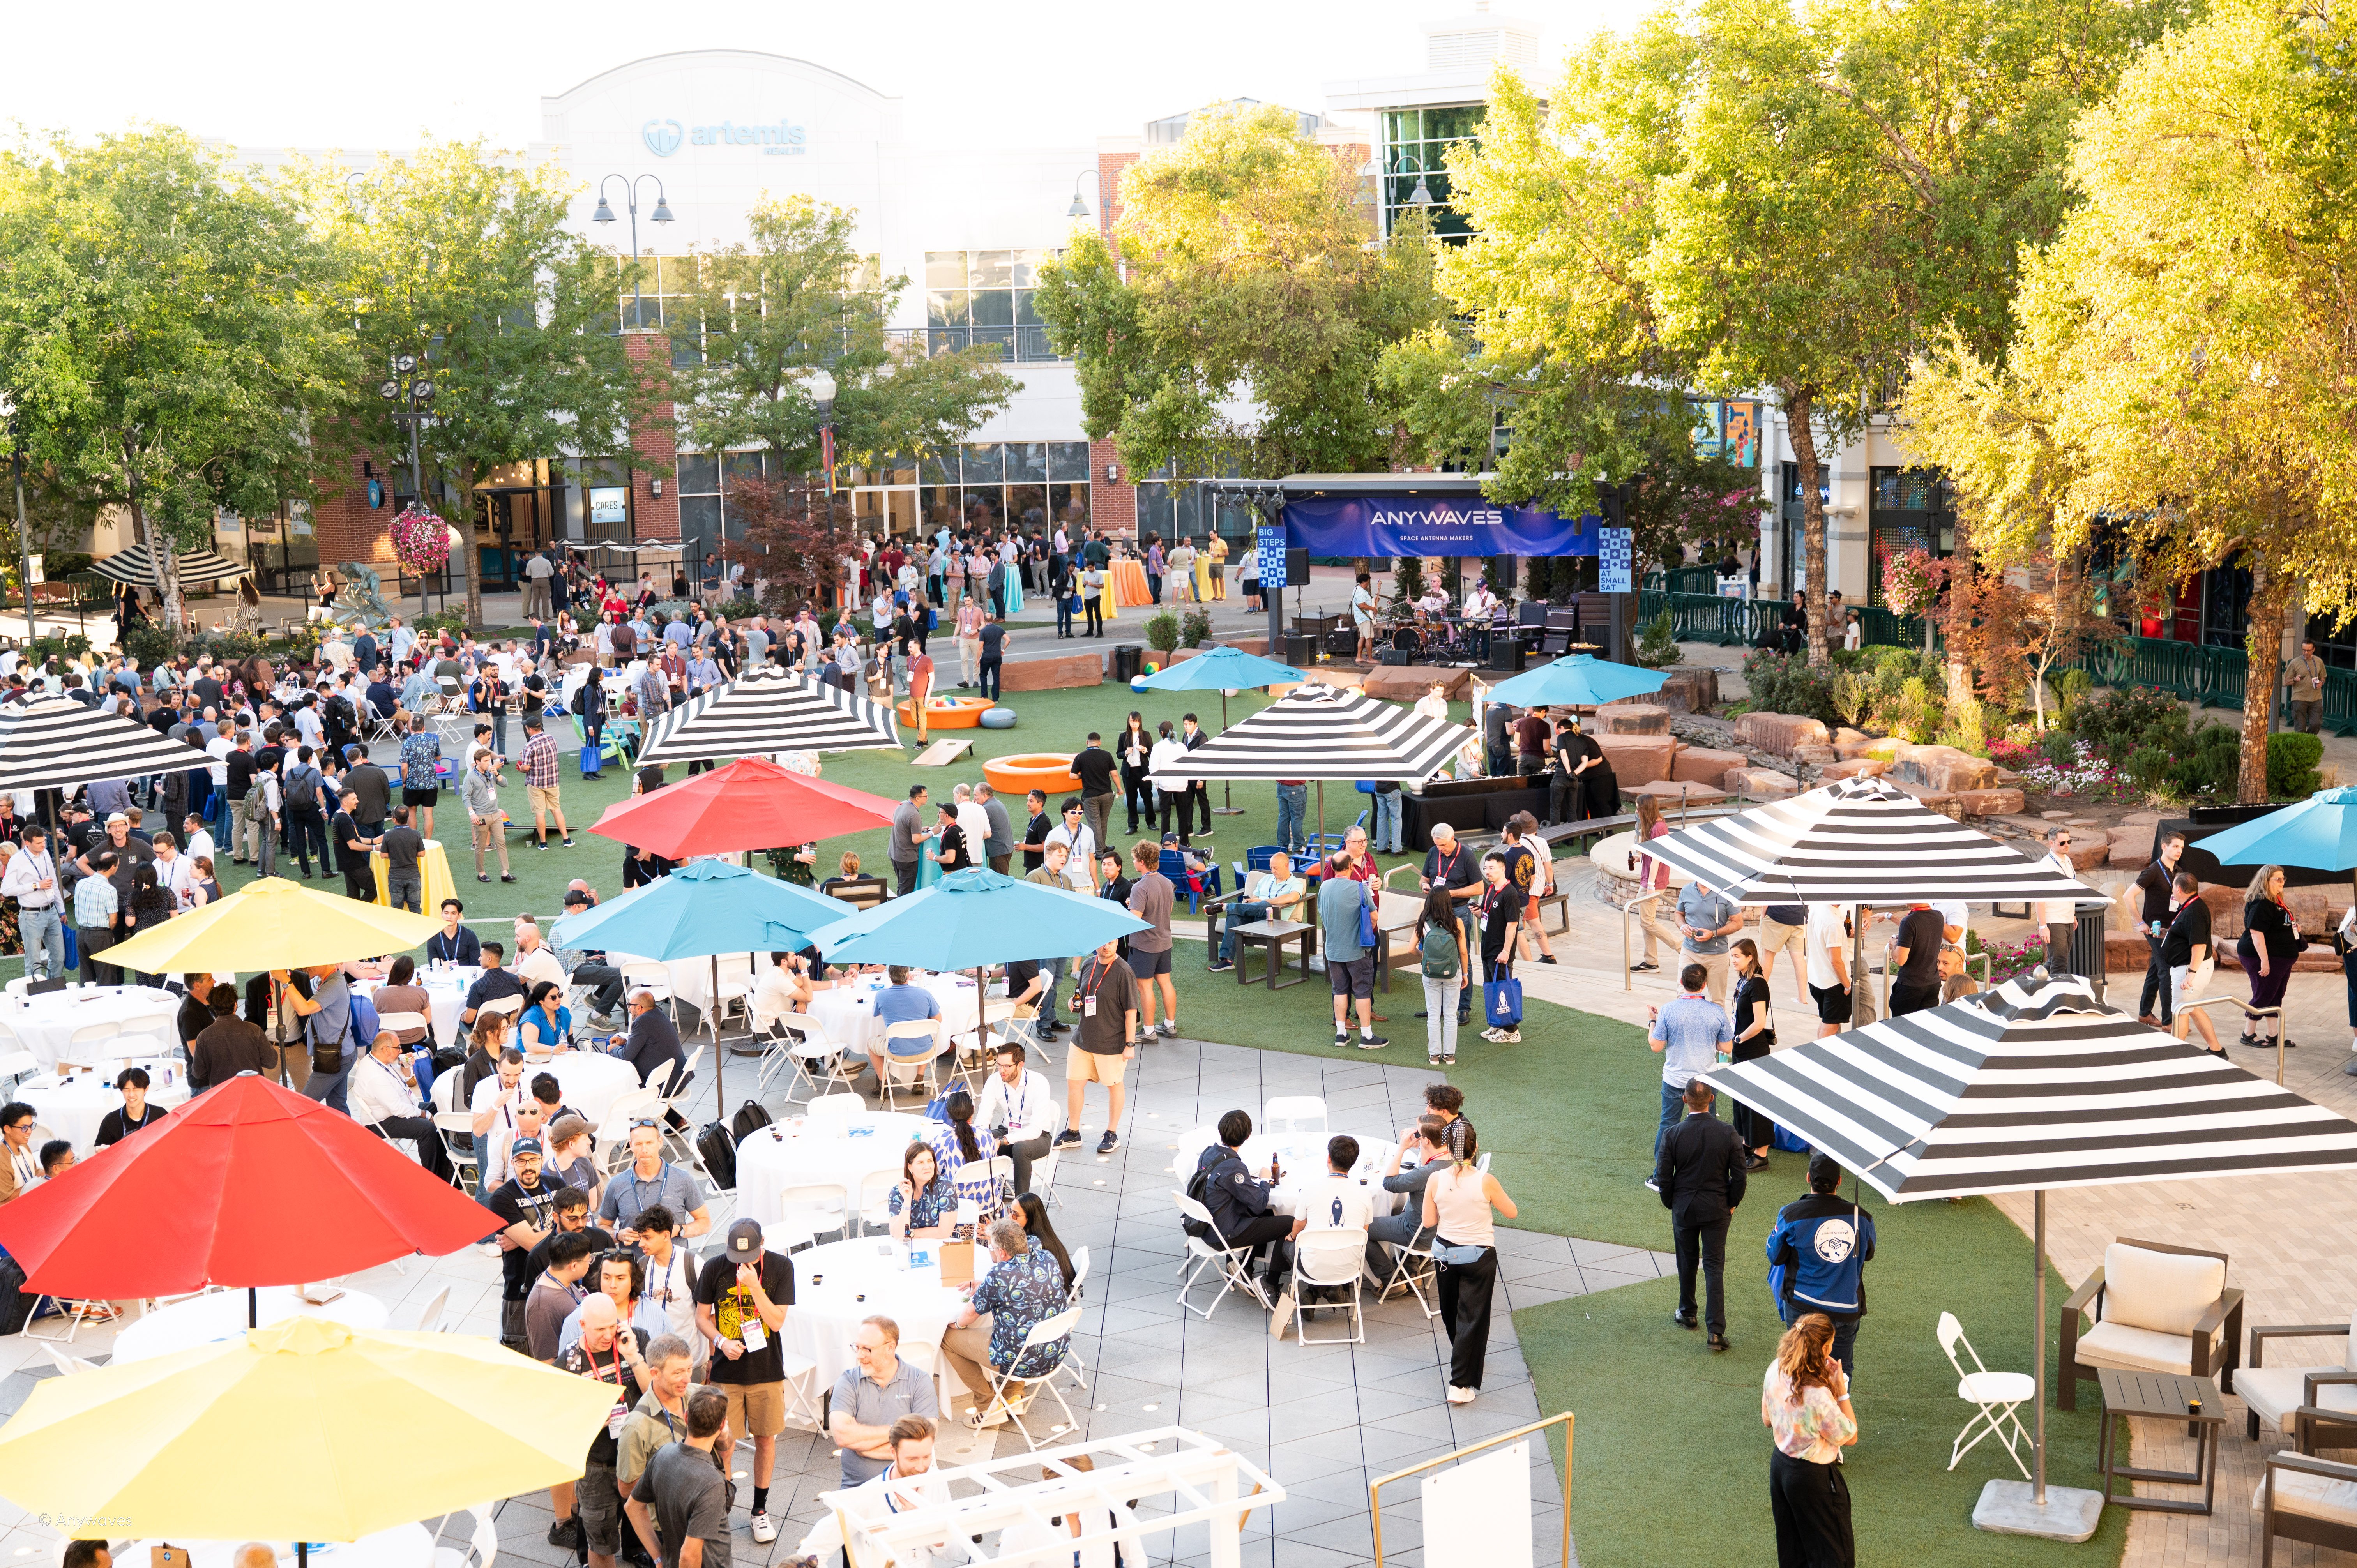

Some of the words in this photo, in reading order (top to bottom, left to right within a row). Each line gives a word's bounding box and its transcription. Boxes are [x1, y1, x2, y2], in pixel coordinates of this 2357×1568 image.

[691, 119, 806, 145] artemis
[764, 147, 806, 155] HEALTH
[596, 501, 618, 510] CARES
[222, 510, 235, 519] CARES
[1371, 511, 1503, 525] ANYWAVES
